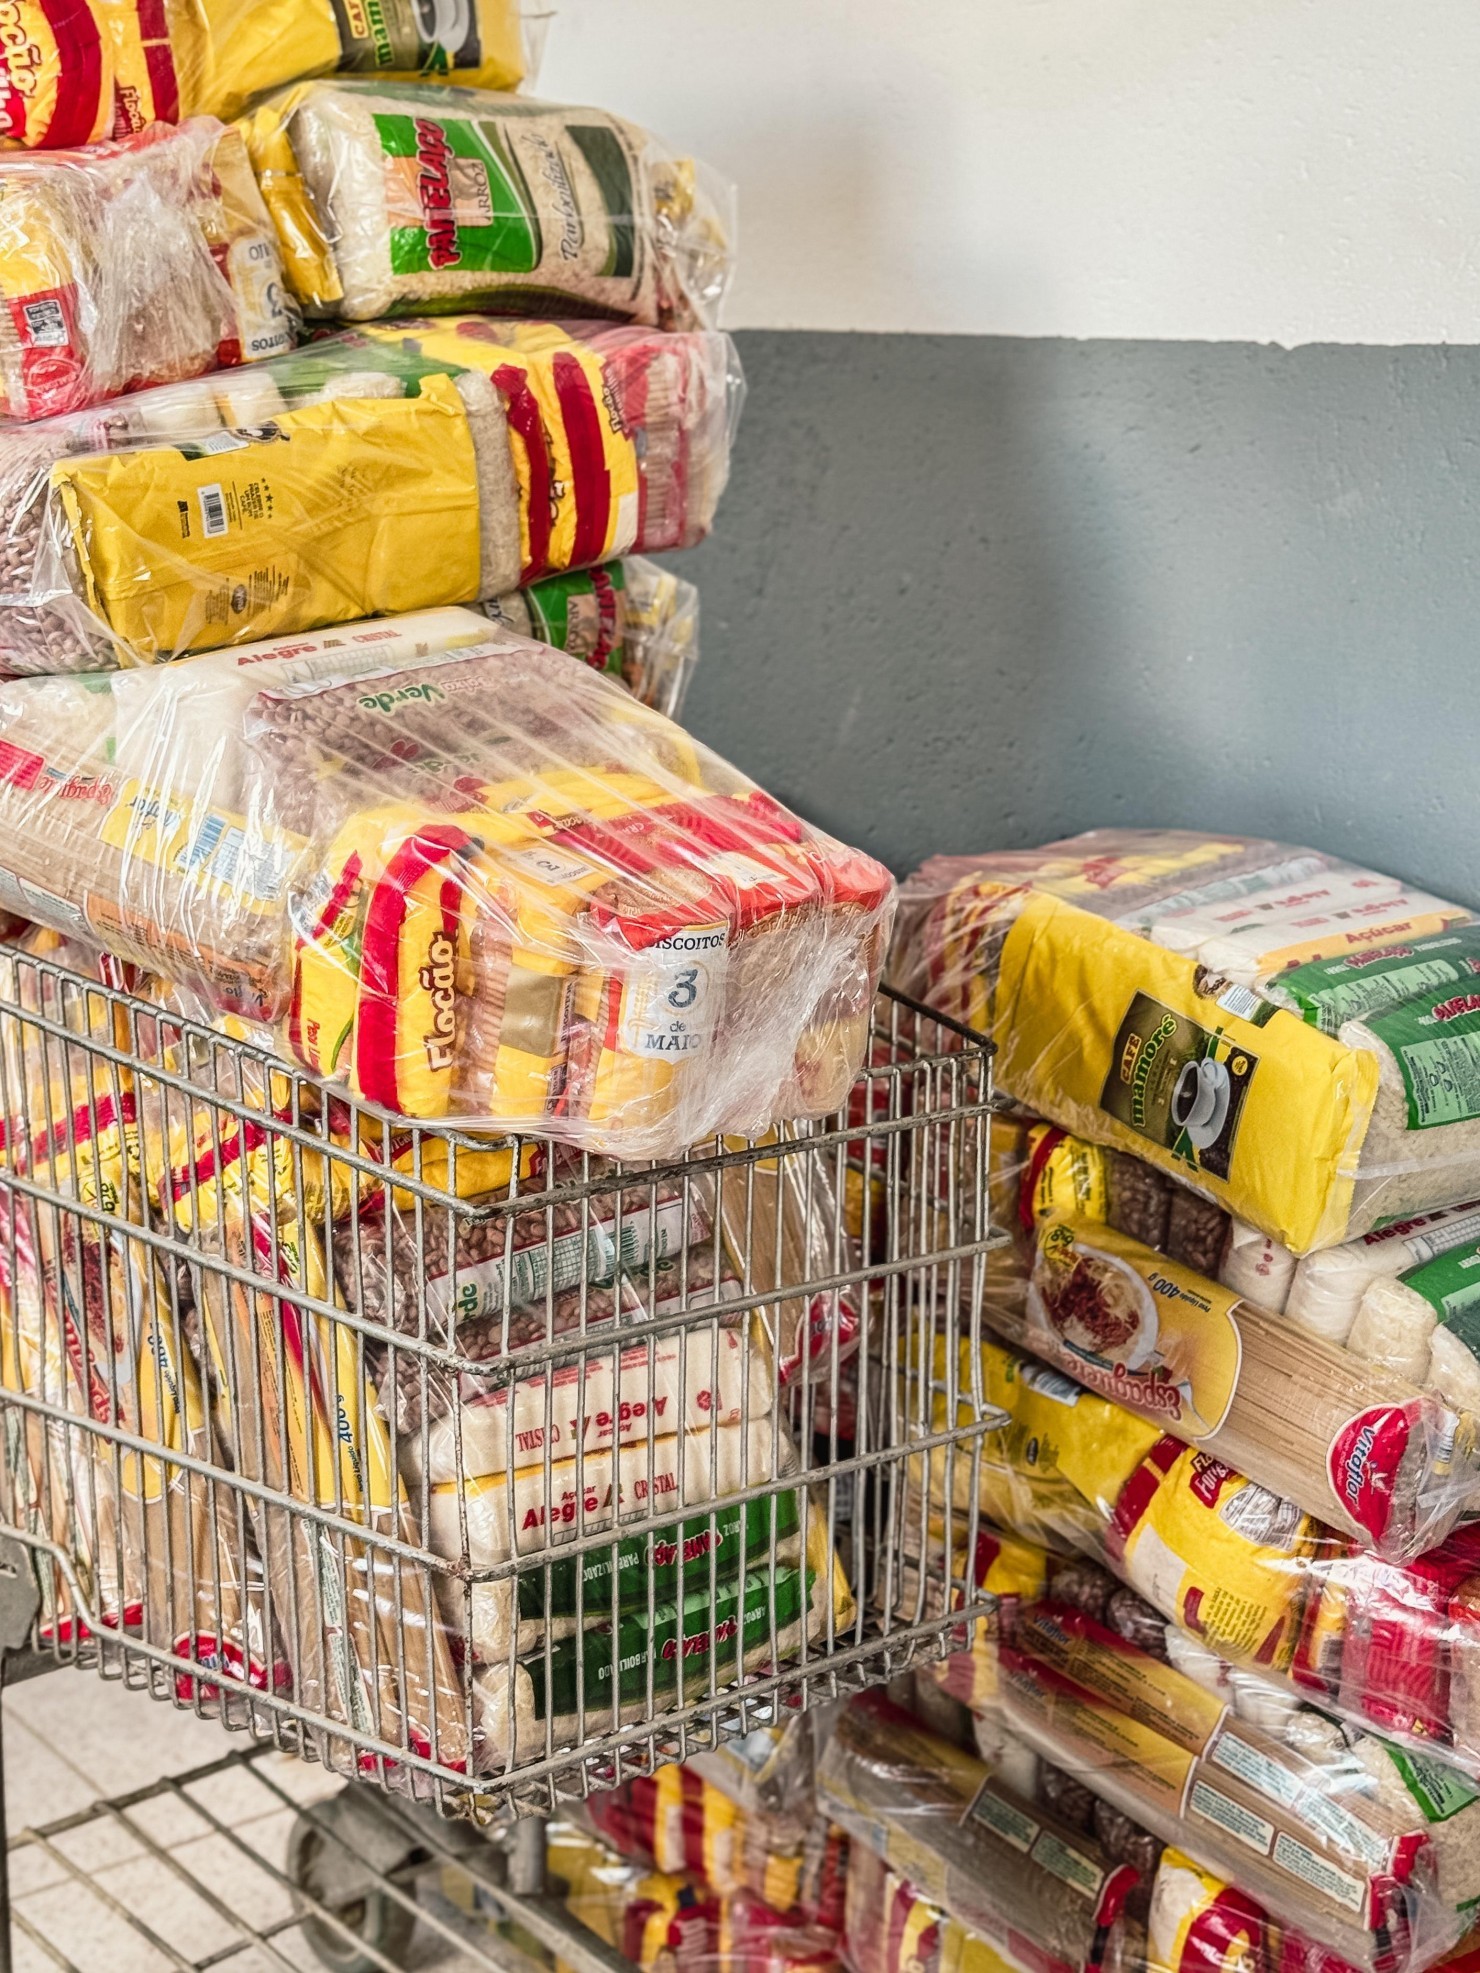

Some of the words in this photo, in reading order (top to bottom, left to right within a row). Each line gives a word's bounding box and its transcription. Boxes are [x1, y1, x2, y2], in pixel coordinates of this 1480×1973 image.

[414, 117, 463, 272] PANELAÇO
[474, 161, 493, 222] ARROZ
[237, 642, 318, 667] Alegre
[359, 682, 445, 713] Verde
[649, 932, 727, 952] ISCOITOS
[1345, 919, 1413, 945] Açúcar
[427, 933, 456, 1072] Flocão
[667, 968, 699, 1009] 3
[669, 1020, 687, 1032] de
[1120, 1034, 1140, 1081] CAFÉ
[1131, 1014, 1178, 1127] mamoré
[1363, 1213, 1427, 1246] Alegre
[1152, 1278, 1180, 1299] 400
[1064, 1354, 1182, 1420] Espaguete
[595, 1395, 668, 1428] Aegre
[597, 1420, 634, 1439] Açcar
[1345, 1425, 1376, 1504] Vitaflor
[561, 1483, 597, 1502] Açcar
[633, 1472, 679, 1500] CRSTAL
[522, 1497, 599, 1531] Alege
